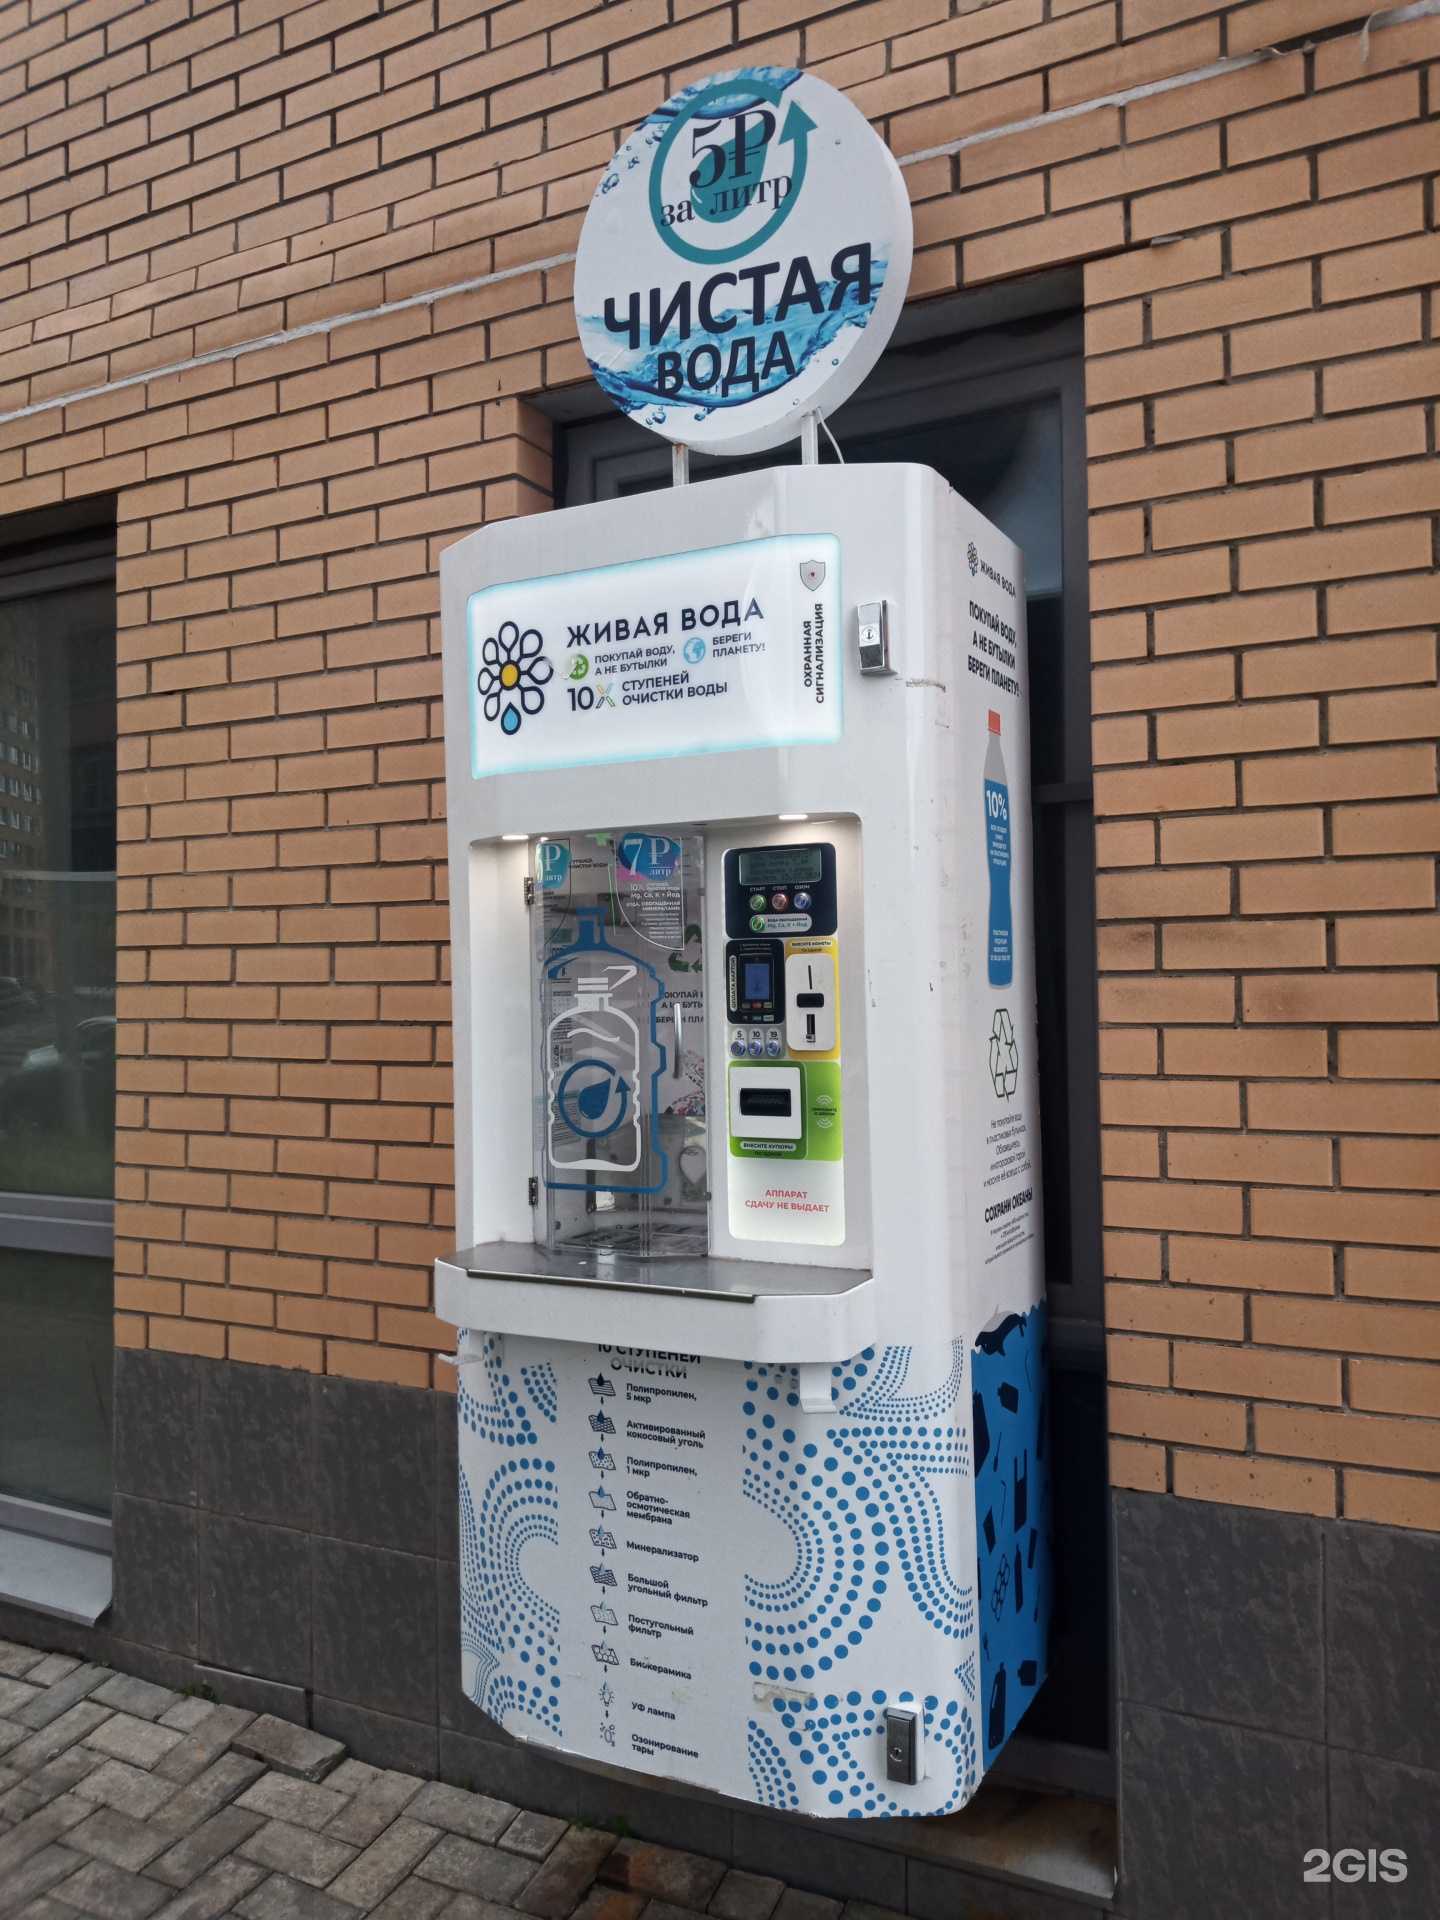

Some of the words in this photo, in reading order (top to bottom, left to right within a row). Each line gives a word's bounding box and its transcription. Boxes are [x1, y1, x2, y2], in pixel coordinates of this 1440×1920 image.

[659, 198, 695, 227] за
[709, 174, 793, 216] литр
[603, 242, 873, 350] ЧИСТАЯ
[656, 331, 797, 398] ВОДА
[980, 560, 1000, 586] ЖИВАЯ
[1001, 576, 1016, 599] ВОДА
[566, 612, 669, 649] ЖИВАЯ
[681, 597, 765, 632] ВОДА
[969, 600, 1000, 635] ПОКУПАЙ
[1000, 620, 1017, 649] ВОДУ,
[712, 632, 752, 646] БЕРЕГИ
[594, 645, 644, 664] ПОКУПАЙ
[646, 644, 676, 659] ВОДУ,
[712, 642, 766, 659] ПЛАНЕТУ!
[803, 620, 813, 688] ОХРАННАЯ
[815, 602, 825, 704] СИГНАЛИЗАЦИЯ
[972, 631, 978, 648] А
[978, 634, 987, 653] НЕ
[988, 641, 1015, 671] БУТЫЛКИ
[594, 666, 602, 677] А
[604, 664, 618, 675] НЕ
[620, 658, 668, 674] БУТЫЛКИ
[968, 654, 990, 682] БЕРЕГИ
[991, 669, 1019, 697] ПЛАНЕТУ!
[622, 670, 690, 692] СТУПЕНЕЙ
[622, 687, 684, 707] ОЧИСТКИ
[687, 681, 728, 698] ВОДЫ
[986, 788, 1008, 822] 10%
[765, 1189, 807, 1199] АППАРАТ
[984, 1195, 1012, 1223] СОХРАНИ
[1012, 1187, 1033, 1211] ОКЕАНЫ
[745, 1200, 774, 1209] СДАЧУ
[776, 1202, 789, 1210] НЕ
[791, 1203, 829, 1213] ВЫДАЕТ
[611, 1357, 687, 1379] ОЧИСТКИ
[626, 1383, 697, 1401] Полипропилен,
[633, 1394, 651, 1405] мкр
[626, 1420, 706, 1440] Активированный
[626, 1431, 675, 1444] кокосовый
[678, 1437, 703, 1449] уголь
[626, 1456, 698, 1476] Полипропилен,
[626, 1466, 630, 1474] 1
[632, 1468, 650, 1478] мкр
[626, 1490, 669, 1504] Обратно-
[626, 1502, 690, 1519] осмотическая
[626, 1511, 673, 1525] мембрана
[626, 1540, 699, 1562] Минерализатор
[628, 1573, 669, 1589] Большой
[628, 1584, 672, 1600] угольный
[674, 1592, 708, 1607] фильтр
[628, 1614, 694, 1636] Постугольный
[628, 1623, 662, 1639] фильтр
[630, 1658, 692, 1680] Биокерамика
[631, 1701, 646, 1712] УФ
[647, 1706, 676, 1720] лампа
[631, 1733, 699, 1758] Озонирование
[632, 1743, 655, 1756] тары
